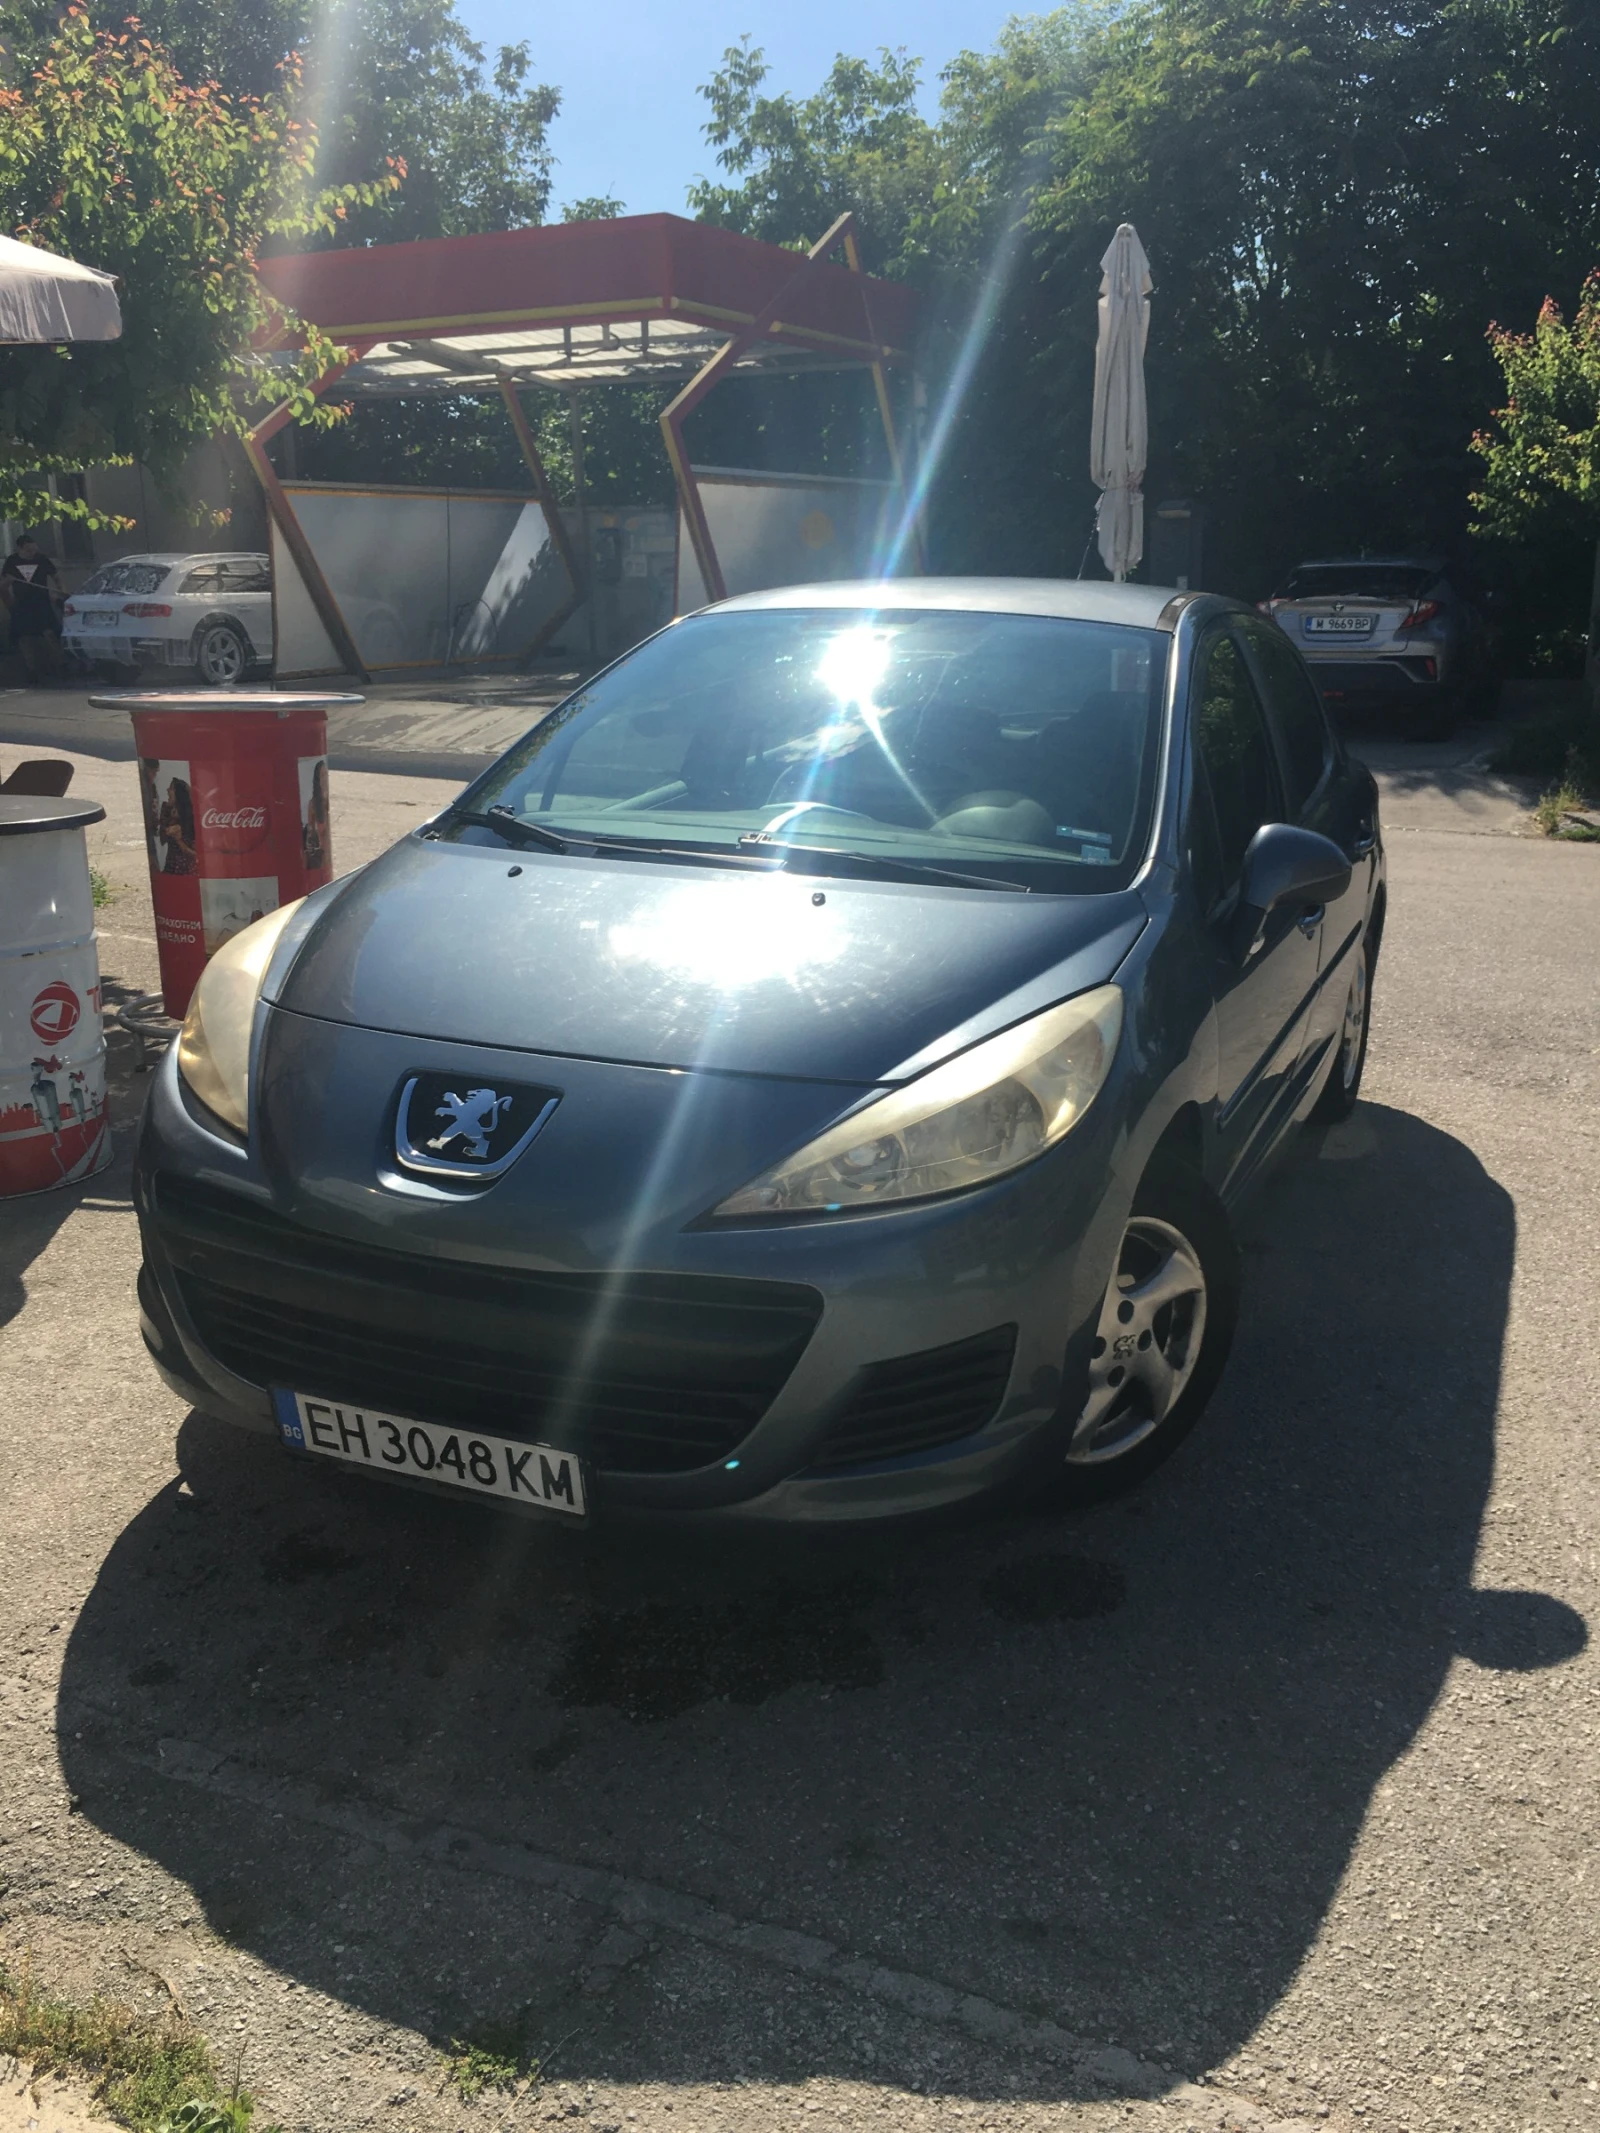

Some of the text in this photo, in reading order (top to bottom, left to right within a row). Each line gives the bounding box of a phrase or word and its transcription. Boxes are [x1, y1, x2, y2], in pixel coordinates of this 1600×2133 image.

[1328, 618, 1354, 629] 9669
[1354, 618, 1369, 629] BP
[201, 806, 267, 829] Coca-Cola
[283, 1423, 302, 1440] BG
[304, 1401, 576, 1506] EH 3048 KM
